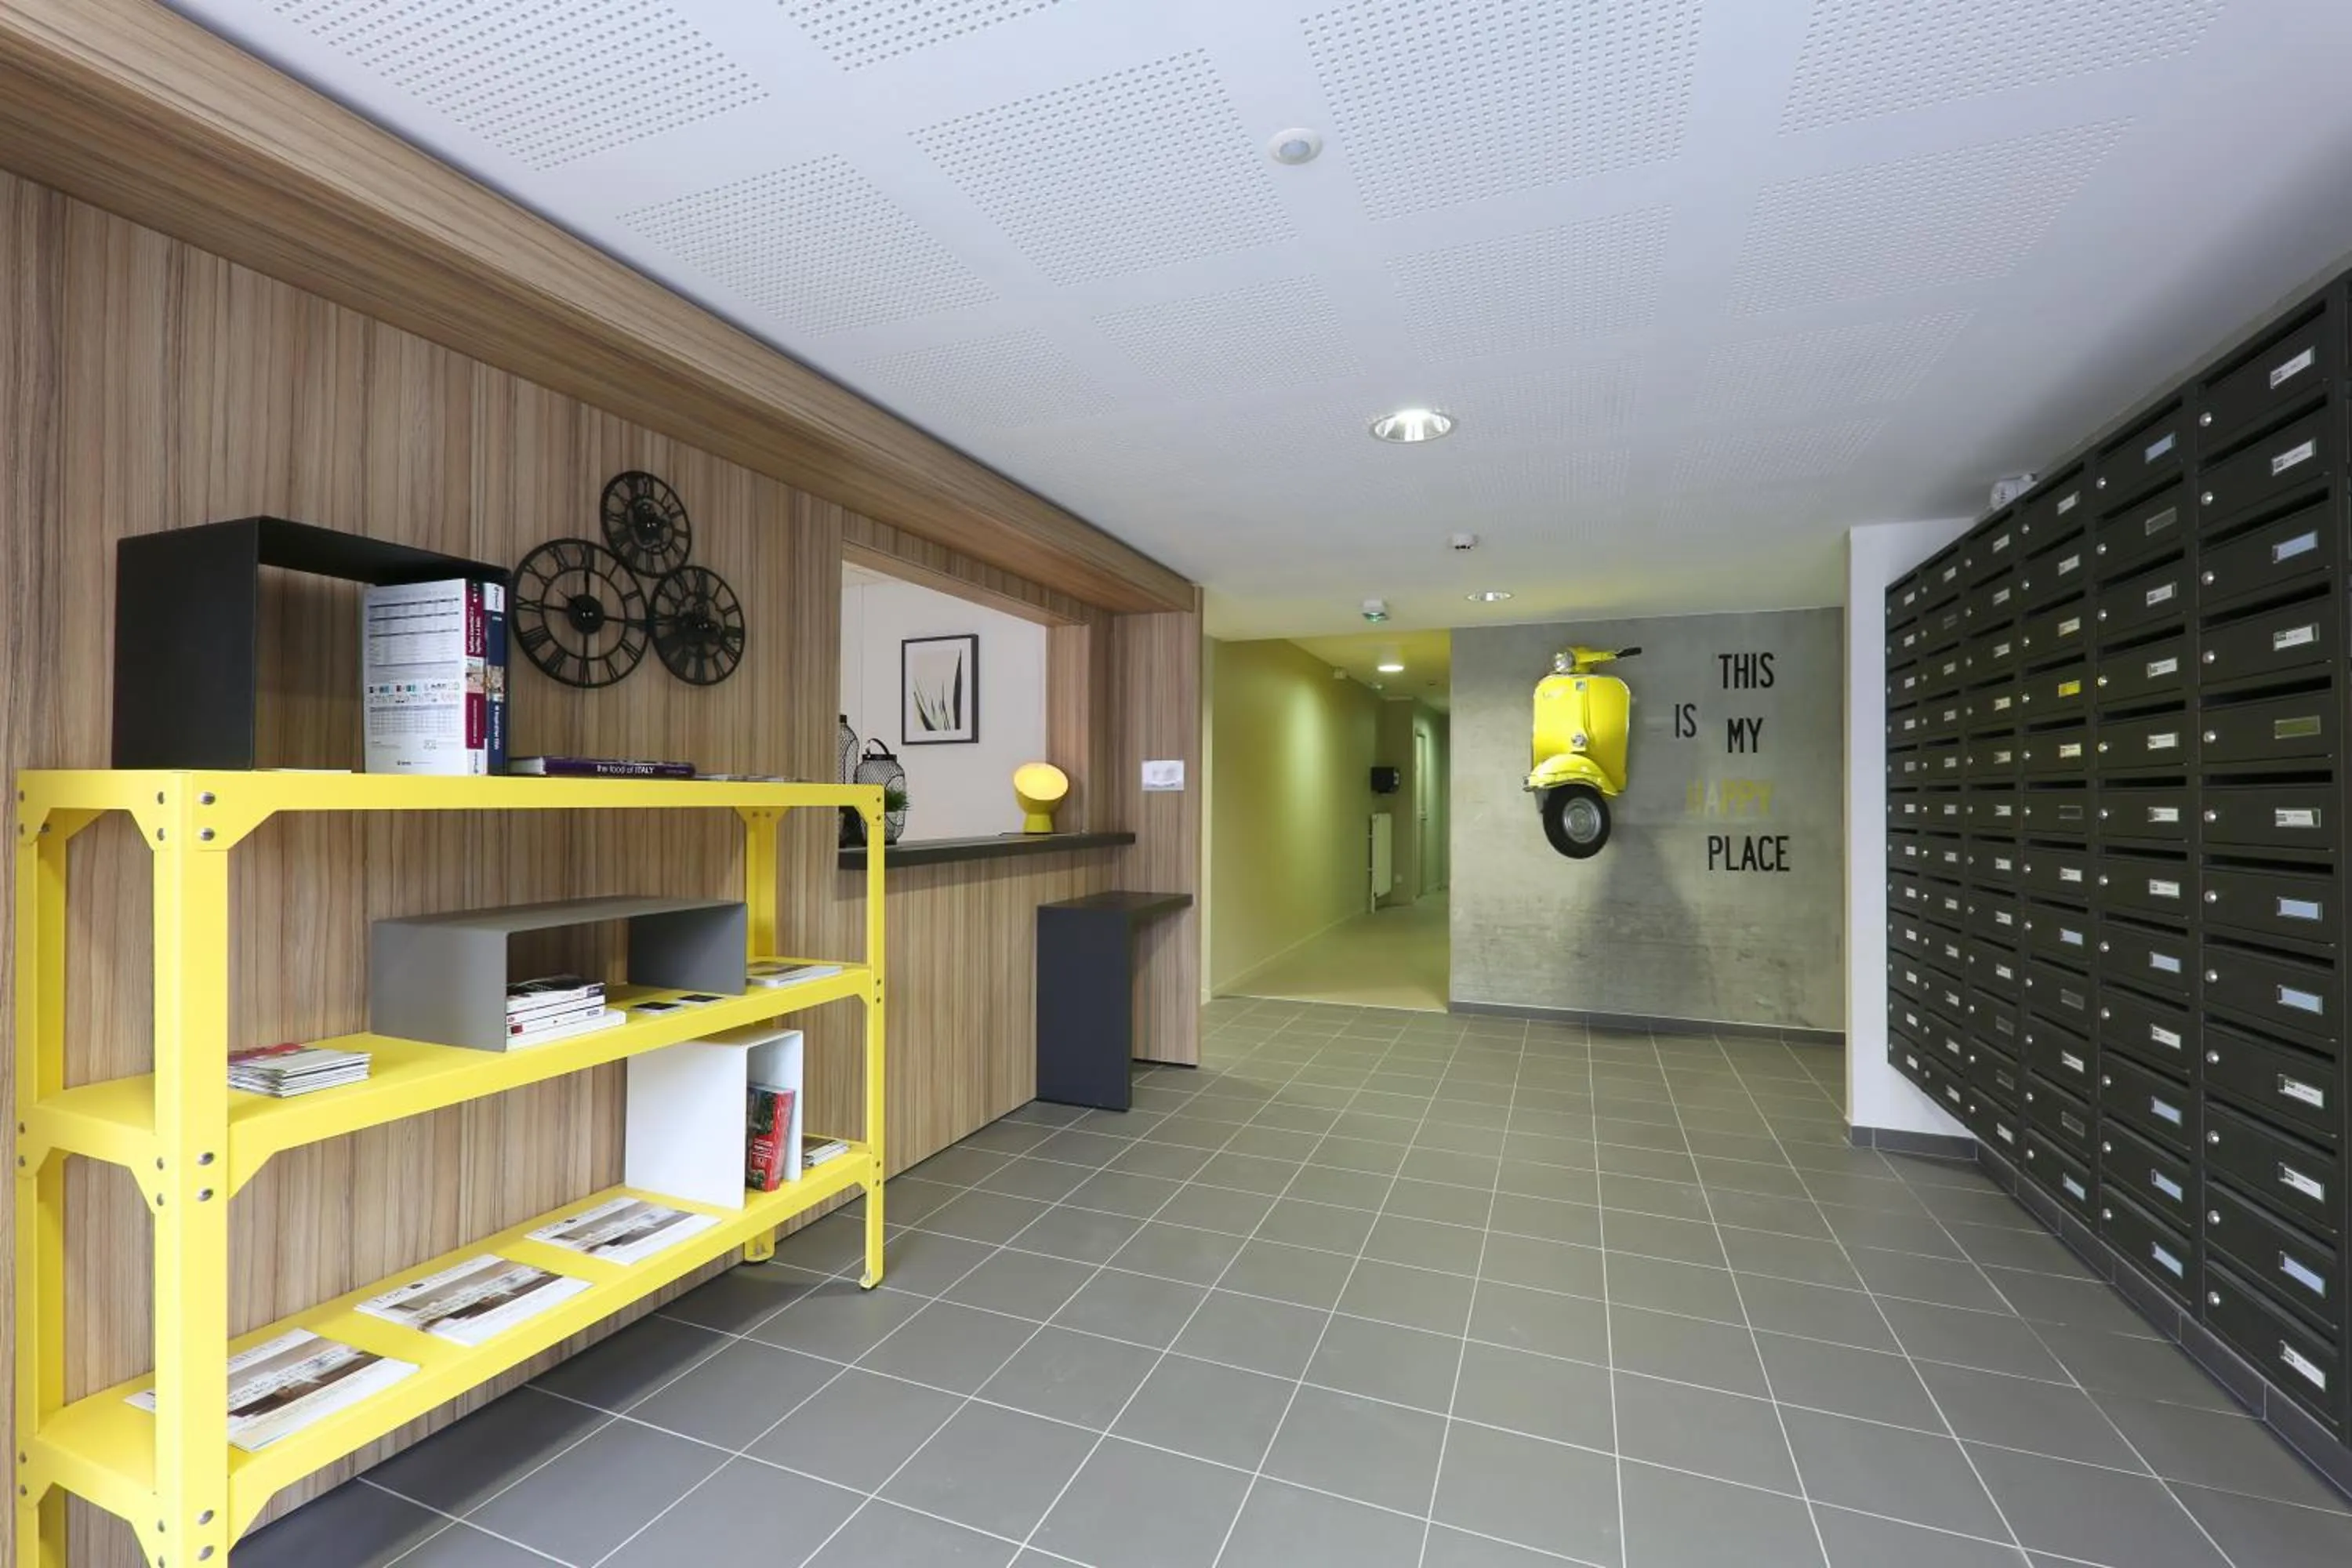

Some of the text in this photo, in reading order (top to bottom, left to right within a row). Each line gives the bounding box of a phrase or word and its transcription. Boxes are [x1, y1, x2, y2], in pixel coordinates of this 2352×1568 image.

[1719, 652, 1774, 689] THIS
[1675, 703, 1763, 753] IS MY
[1686, 779, 1774, 816] HAPPY
[1708, 835, 1791, 872] PLACE
